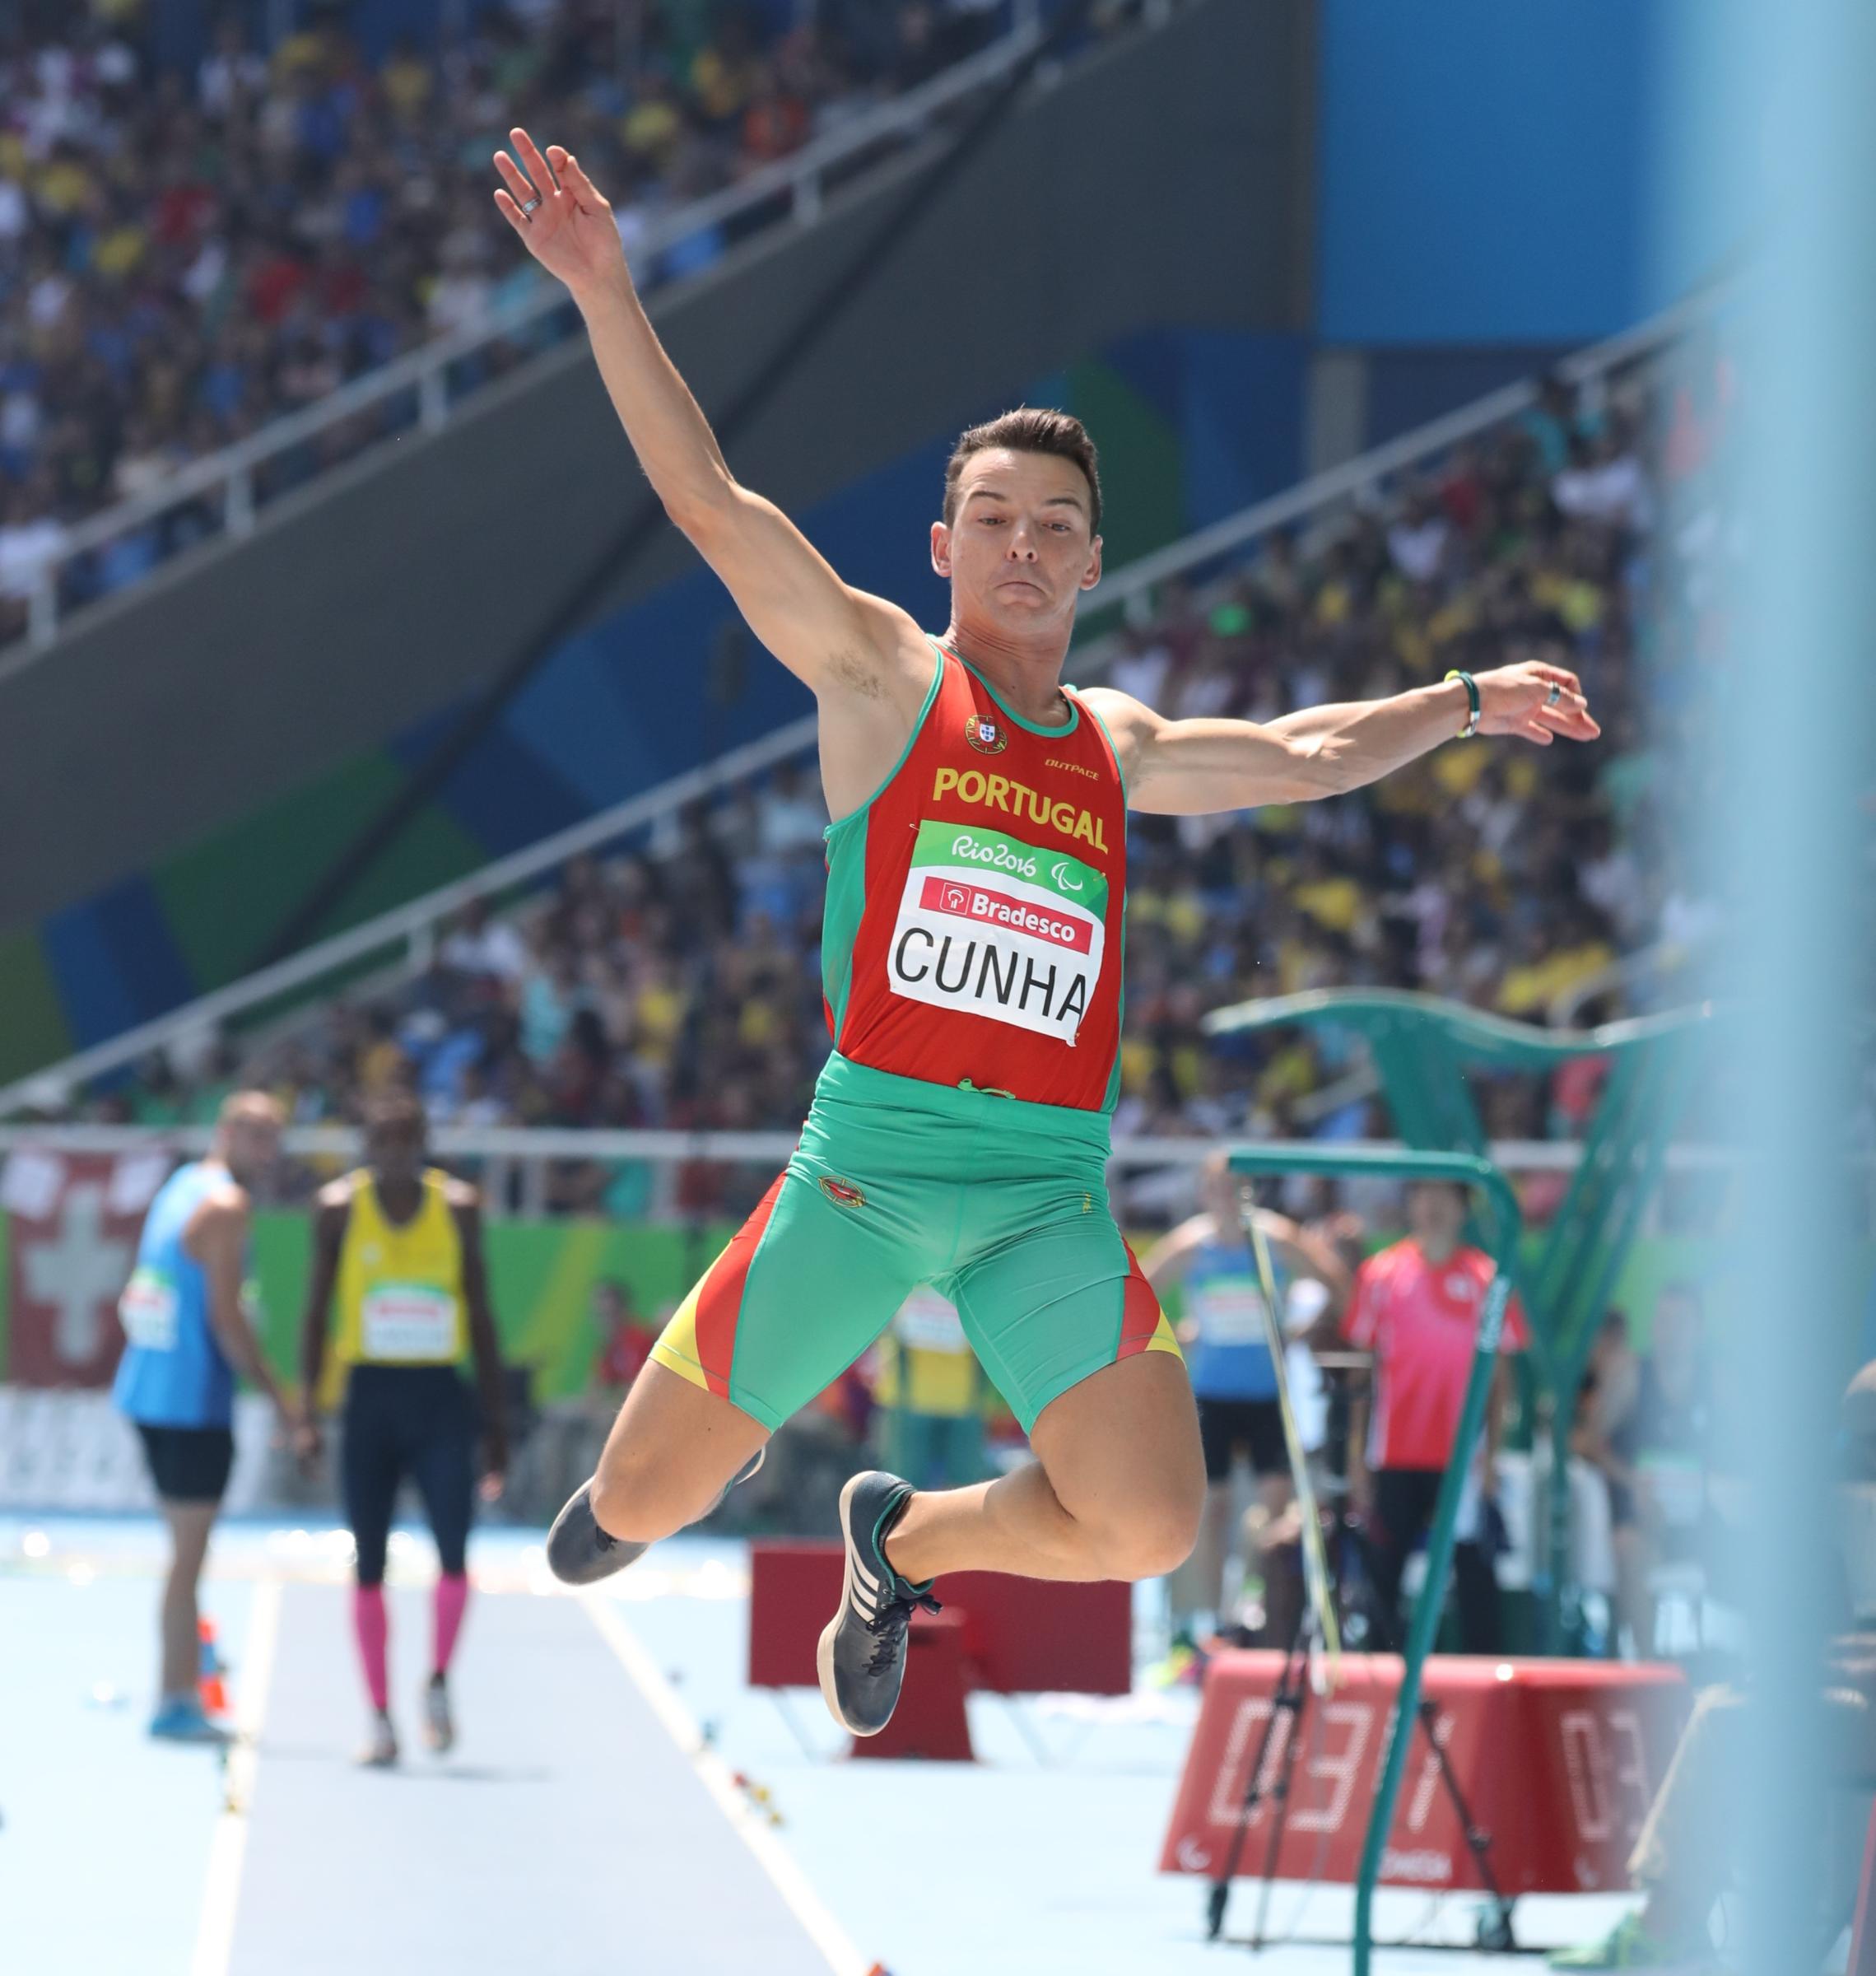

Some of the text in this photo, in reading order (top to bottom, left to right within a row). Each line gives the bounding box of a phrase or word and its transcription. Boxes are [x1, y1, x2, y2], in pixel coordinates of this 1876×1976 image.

[1044, 758, 1100, 781] OUTPACE
[933, 768, 1108, 855] PORTUGAL
[971, 892, 1075, 943] Bradesco
[895, 927, 1086, 1023] CUNHA
